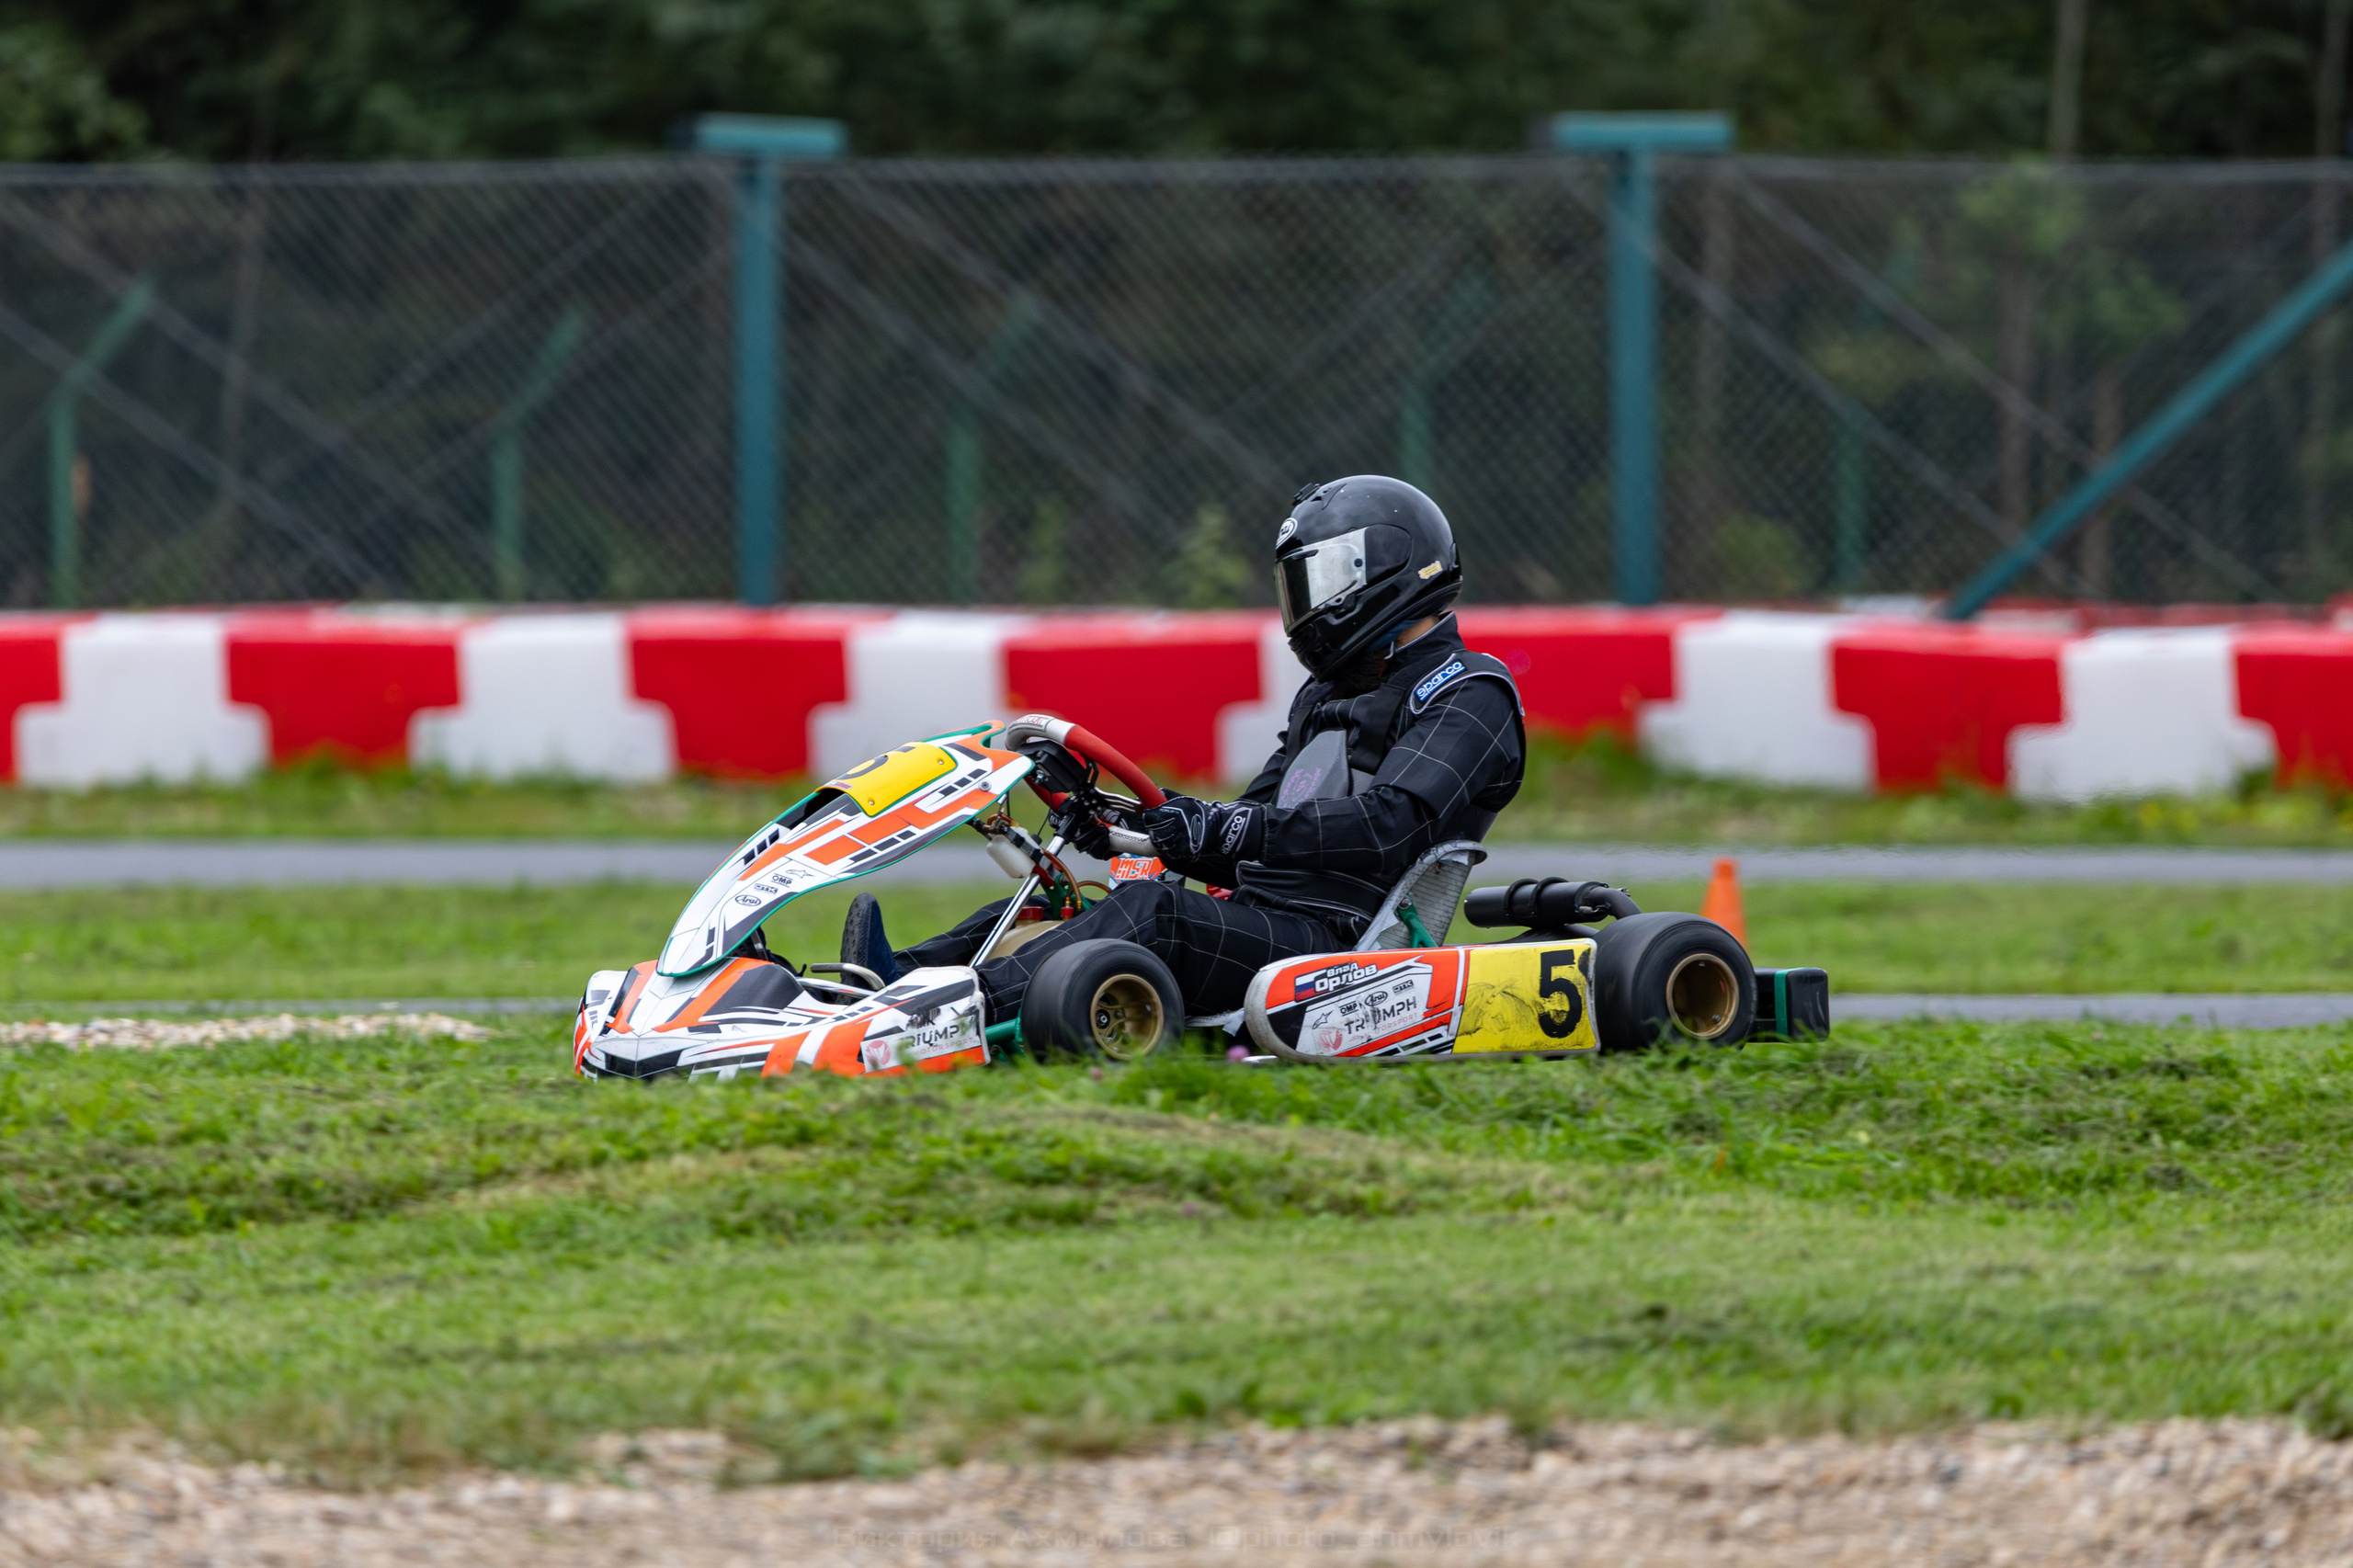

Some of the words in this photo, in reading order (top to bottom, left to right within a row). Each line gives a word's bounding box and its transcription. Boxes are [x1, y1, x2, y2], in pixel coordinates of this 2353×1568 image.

[1416, 662, 1464, 699] sparco
[772, 875, 792, 885] OMP
[1538, 949, 1583, 1039] 5
[1340, 1003, 1358, 1015] OMP
[897, 1020, 971, 1048] RIUMP
